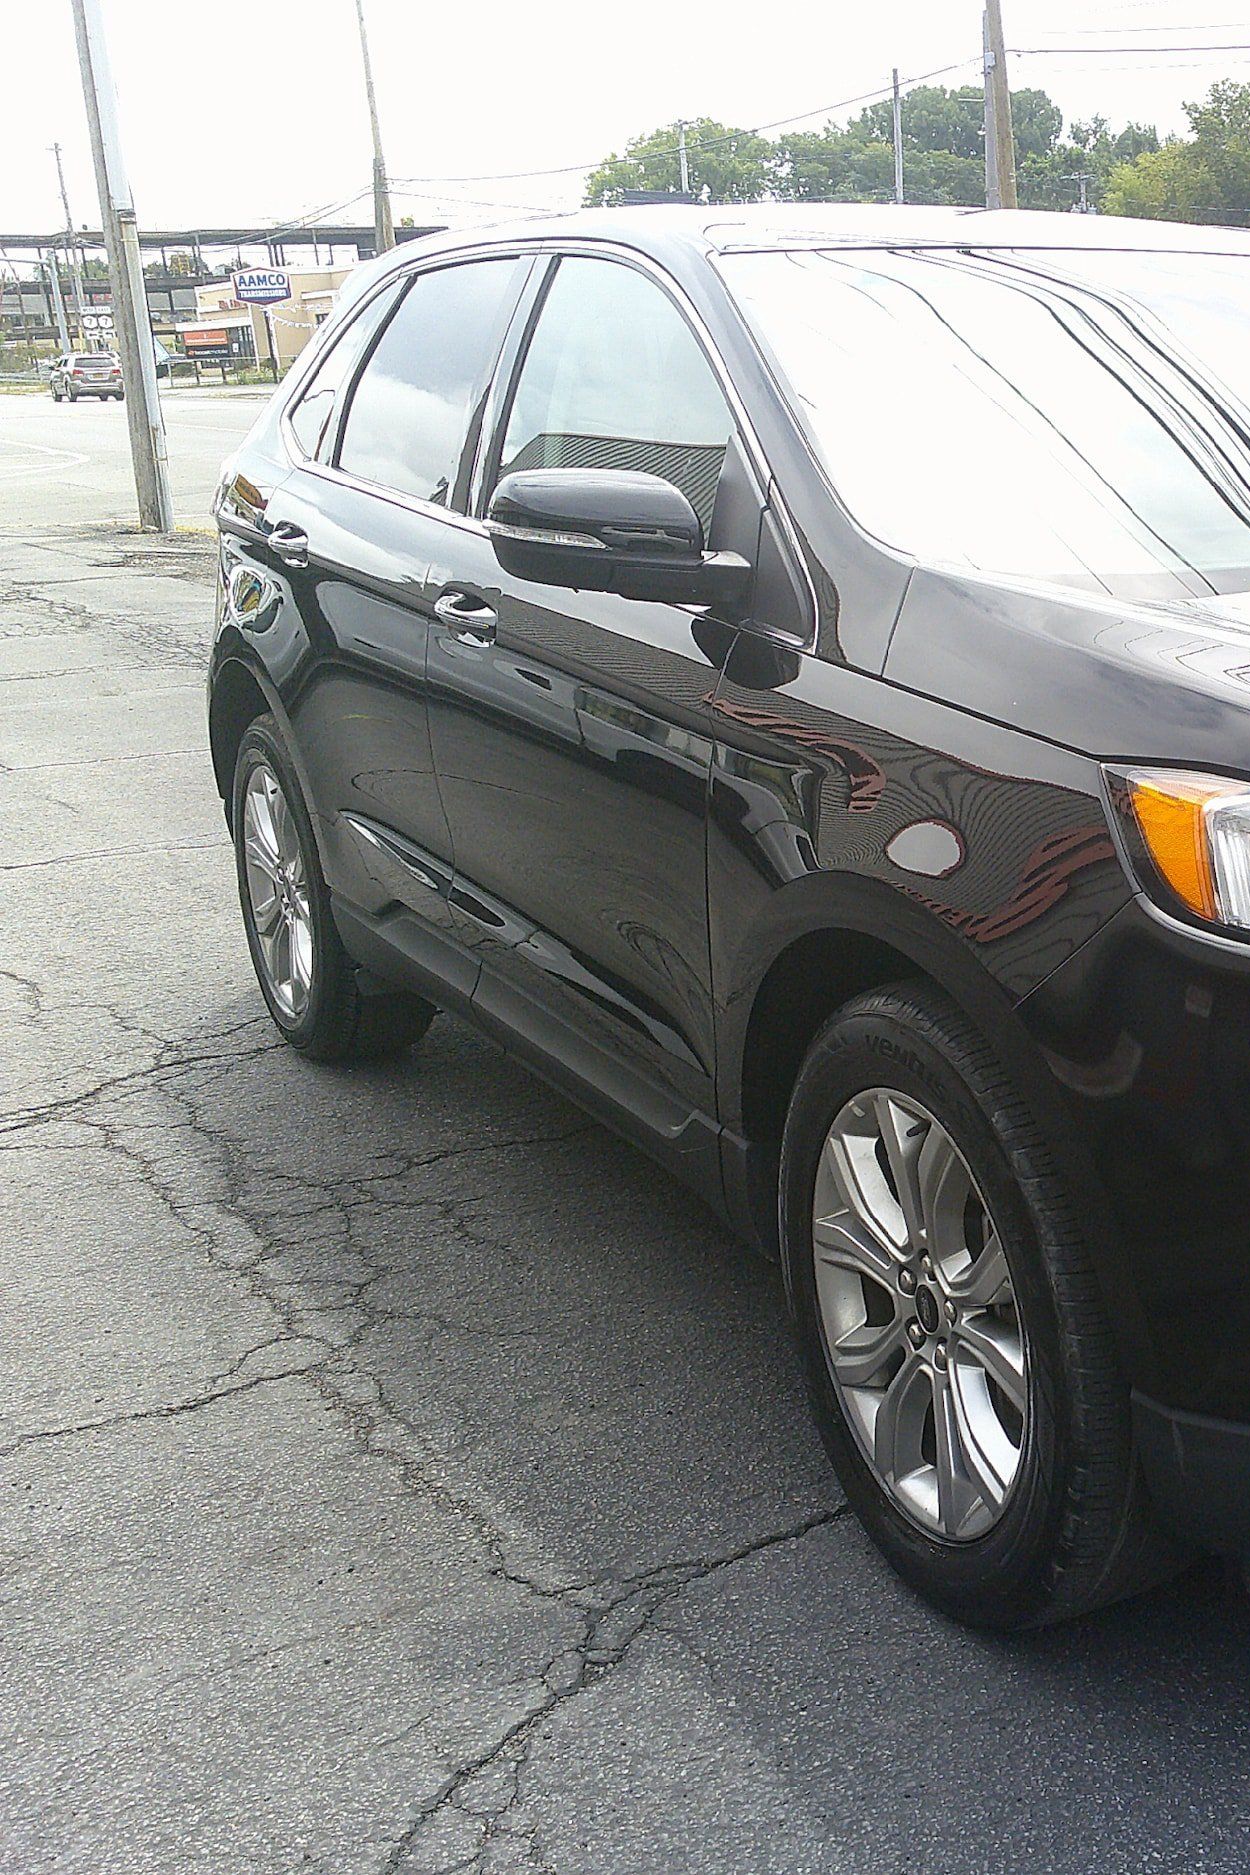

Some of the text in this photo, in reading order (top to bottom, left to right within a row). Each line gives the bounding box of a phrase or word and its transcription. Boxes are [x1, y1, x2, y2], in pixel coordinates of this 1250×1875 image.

[238, 274, 285, 287] AAMCO
[87, 317, 108, 325] 7 7
